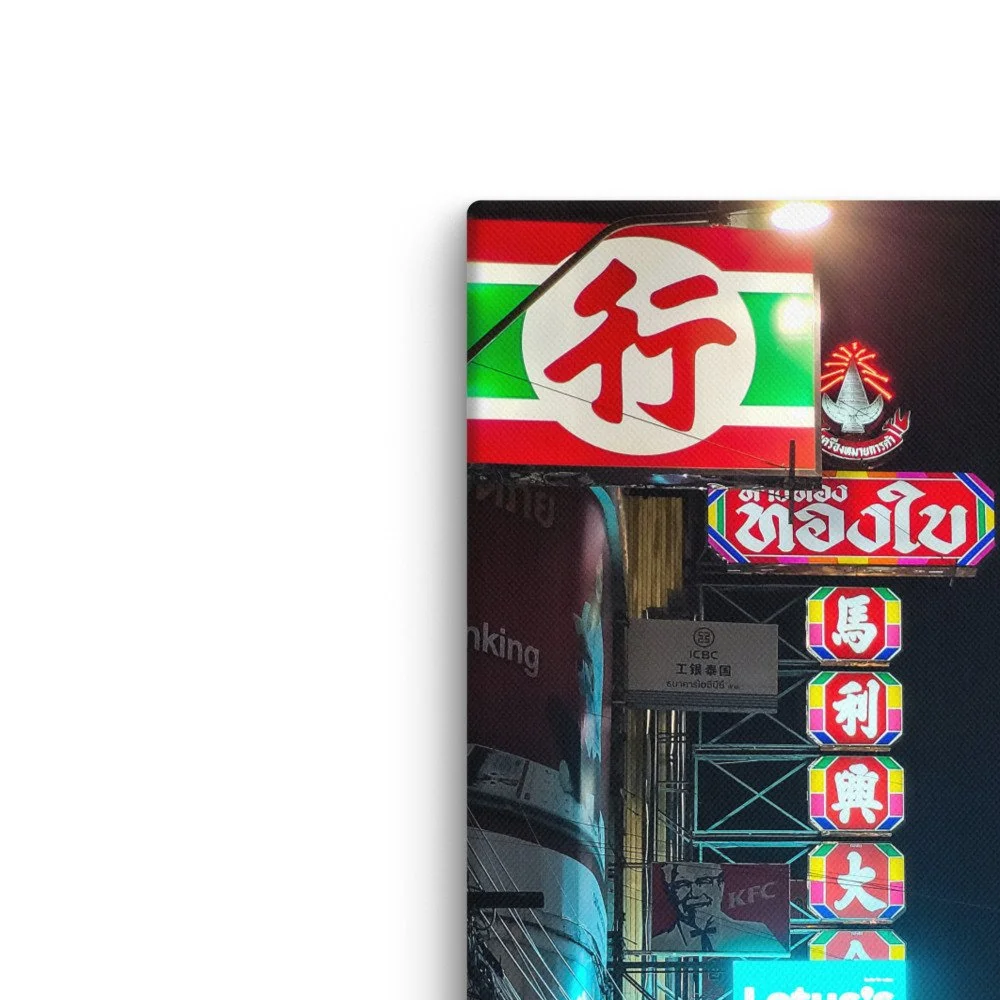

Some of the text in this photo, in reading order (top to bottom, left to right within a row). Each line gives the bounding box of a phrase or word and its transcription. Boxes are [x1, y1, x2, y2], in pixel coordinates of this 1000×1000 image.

[543, 257, 736, 433] 行
[821, 434, 896, 457] ครื่องหมายการค้า
[689, 650, 719, 660] ICBC
[727, 881, 777, 910] KFC
